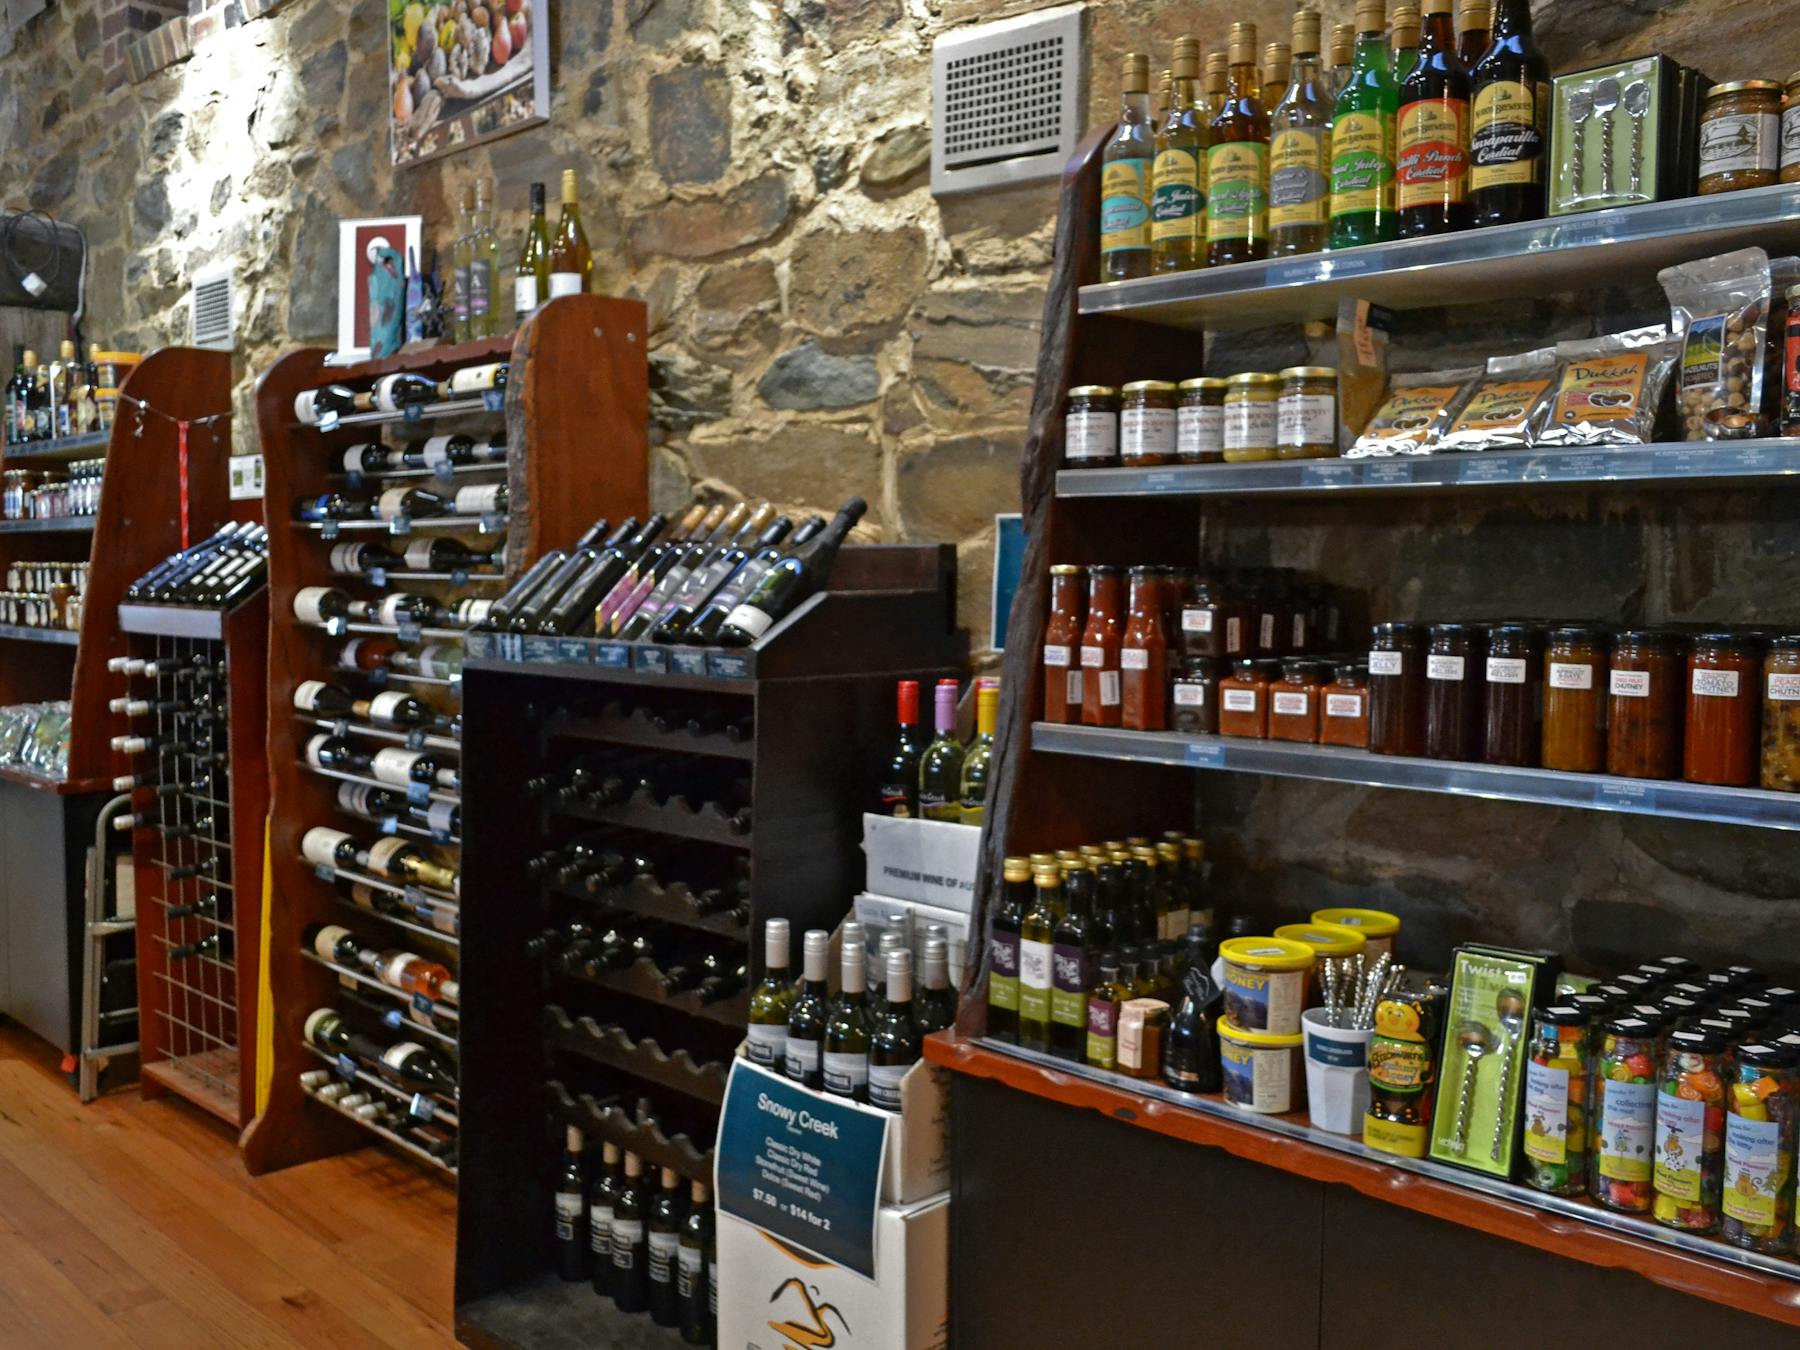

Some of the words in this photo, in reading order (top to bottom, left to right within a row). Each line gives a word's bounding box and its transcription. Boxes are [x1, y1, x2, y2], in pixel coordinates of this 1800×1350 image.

[1477, 144, 1523, 164] Cordial
[1406, 163, 1448, 180] Cordial
[1571, 364, 1638, 381] Dukkah
[883, 865, 922, 882] PREMIUM
[922, 872, 945, 887] WINE
[945, 877, 958, 888] OF
[1460, 959, 1502, 978] Twist
[757, 1092, 798, 1126] Snowy
[798, 1109, 840, 1140] Creek
[765, 1136, 790, 1154] Classic
[788, 1145, 802, 1160] Dry
[801, 1151, 822, 1168] White
[766, 1148, 791, 1166] Classic
[790, 1157, 804, 1172] Dry
[789, 1203, 808, 1221] $14
[808, 1211, 822, 1227] for
[822, 1217, 832, 1231] 2
